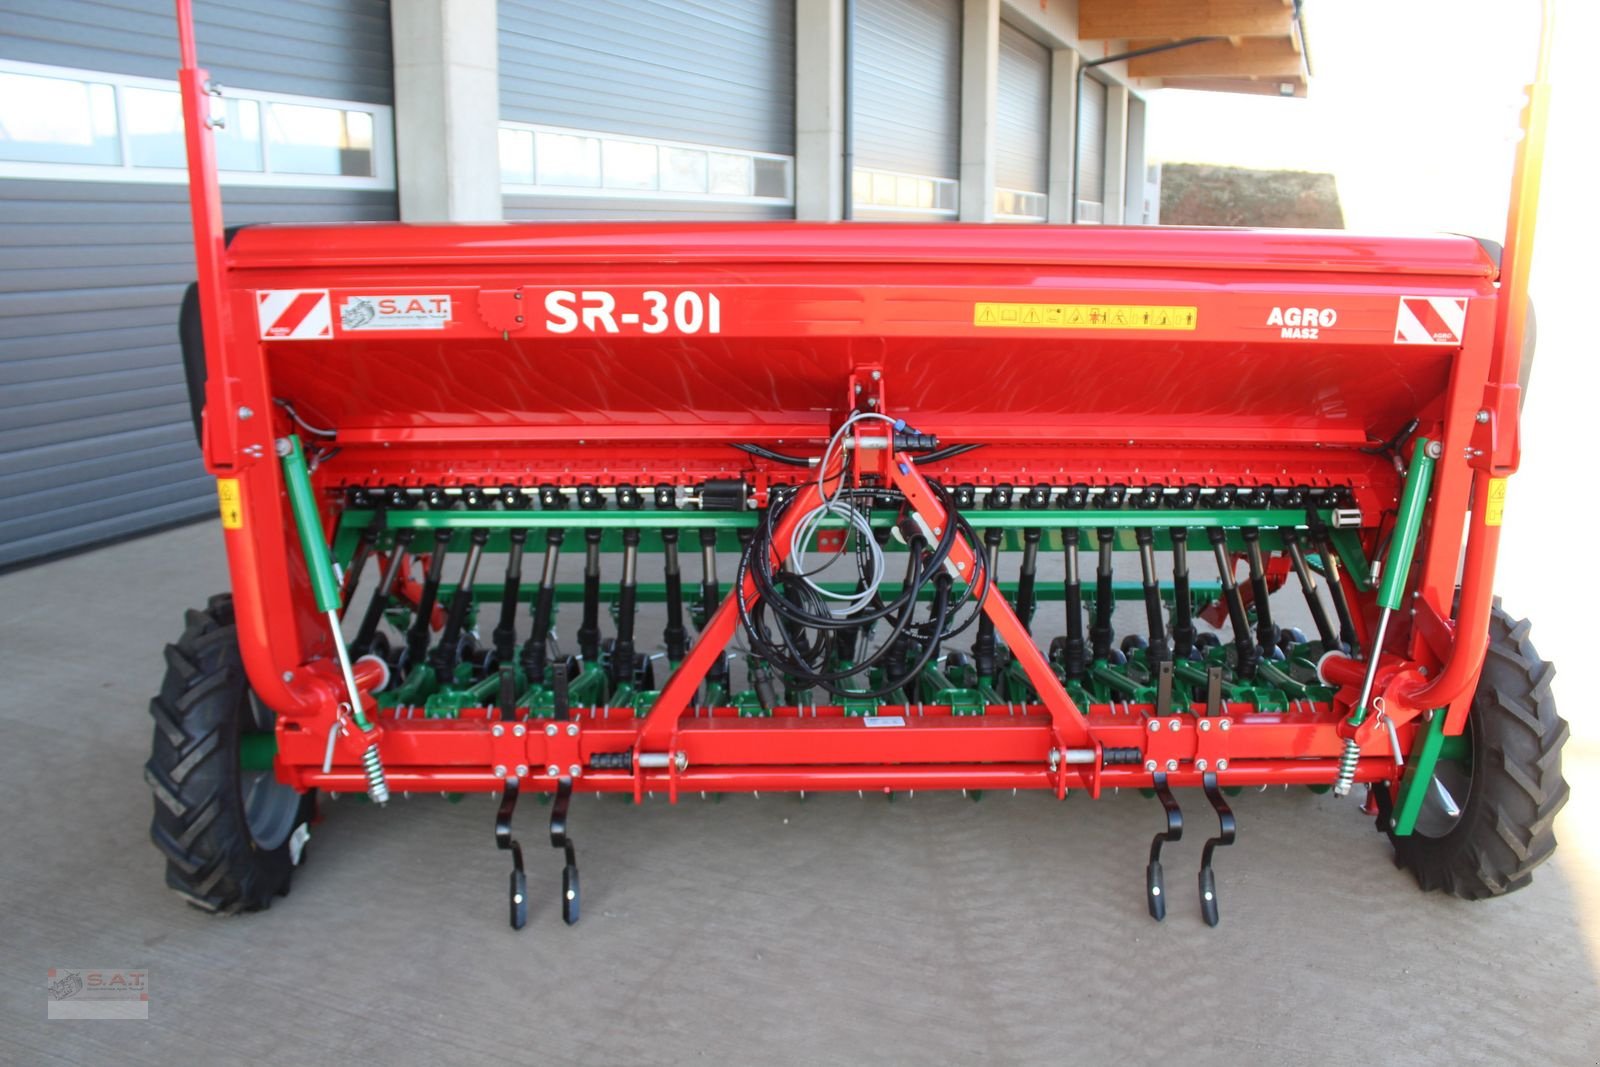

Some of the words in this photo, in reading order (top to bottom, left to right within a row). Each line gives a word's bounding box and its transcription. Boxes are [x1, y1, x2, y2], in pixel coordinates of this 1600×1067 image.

[378, 298, 448, 315] S.A.T.
[1266, 307, 1337, 328] AGRO
[1281, 327, 1319, 340] MASZ
